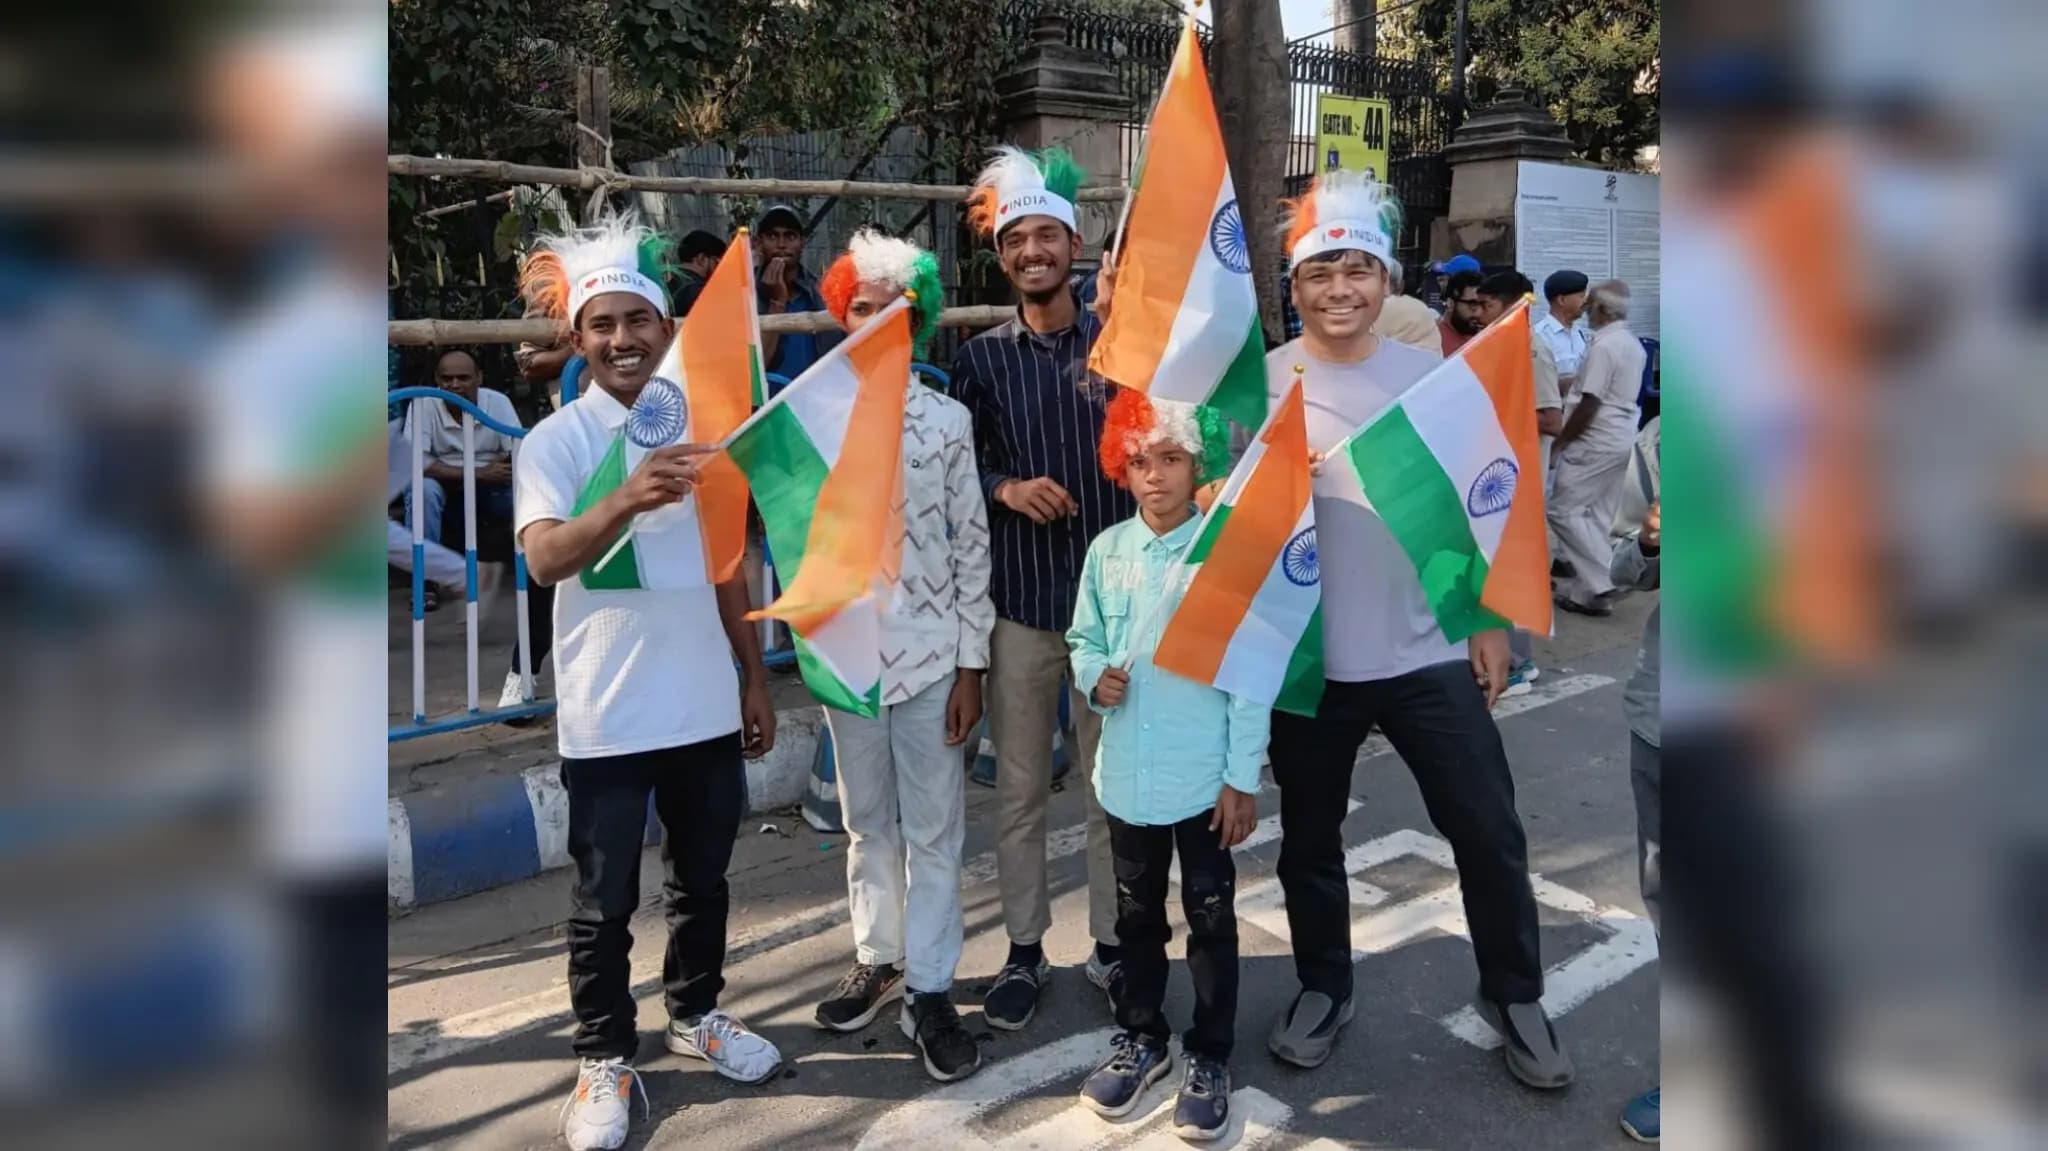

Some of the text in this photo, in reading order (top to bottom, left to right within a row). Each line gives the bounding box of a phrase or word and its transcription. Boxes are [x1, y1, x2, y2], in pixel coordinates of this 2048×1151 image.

[1323, 113, 1341, 135] GATE
[1363, 107, 1384, 151] 4A
[1009, 195, 1048, 211] INDIA
[1349, 228, 1384, 247] INDIA
[602, 273, 647, 290] INDIA
